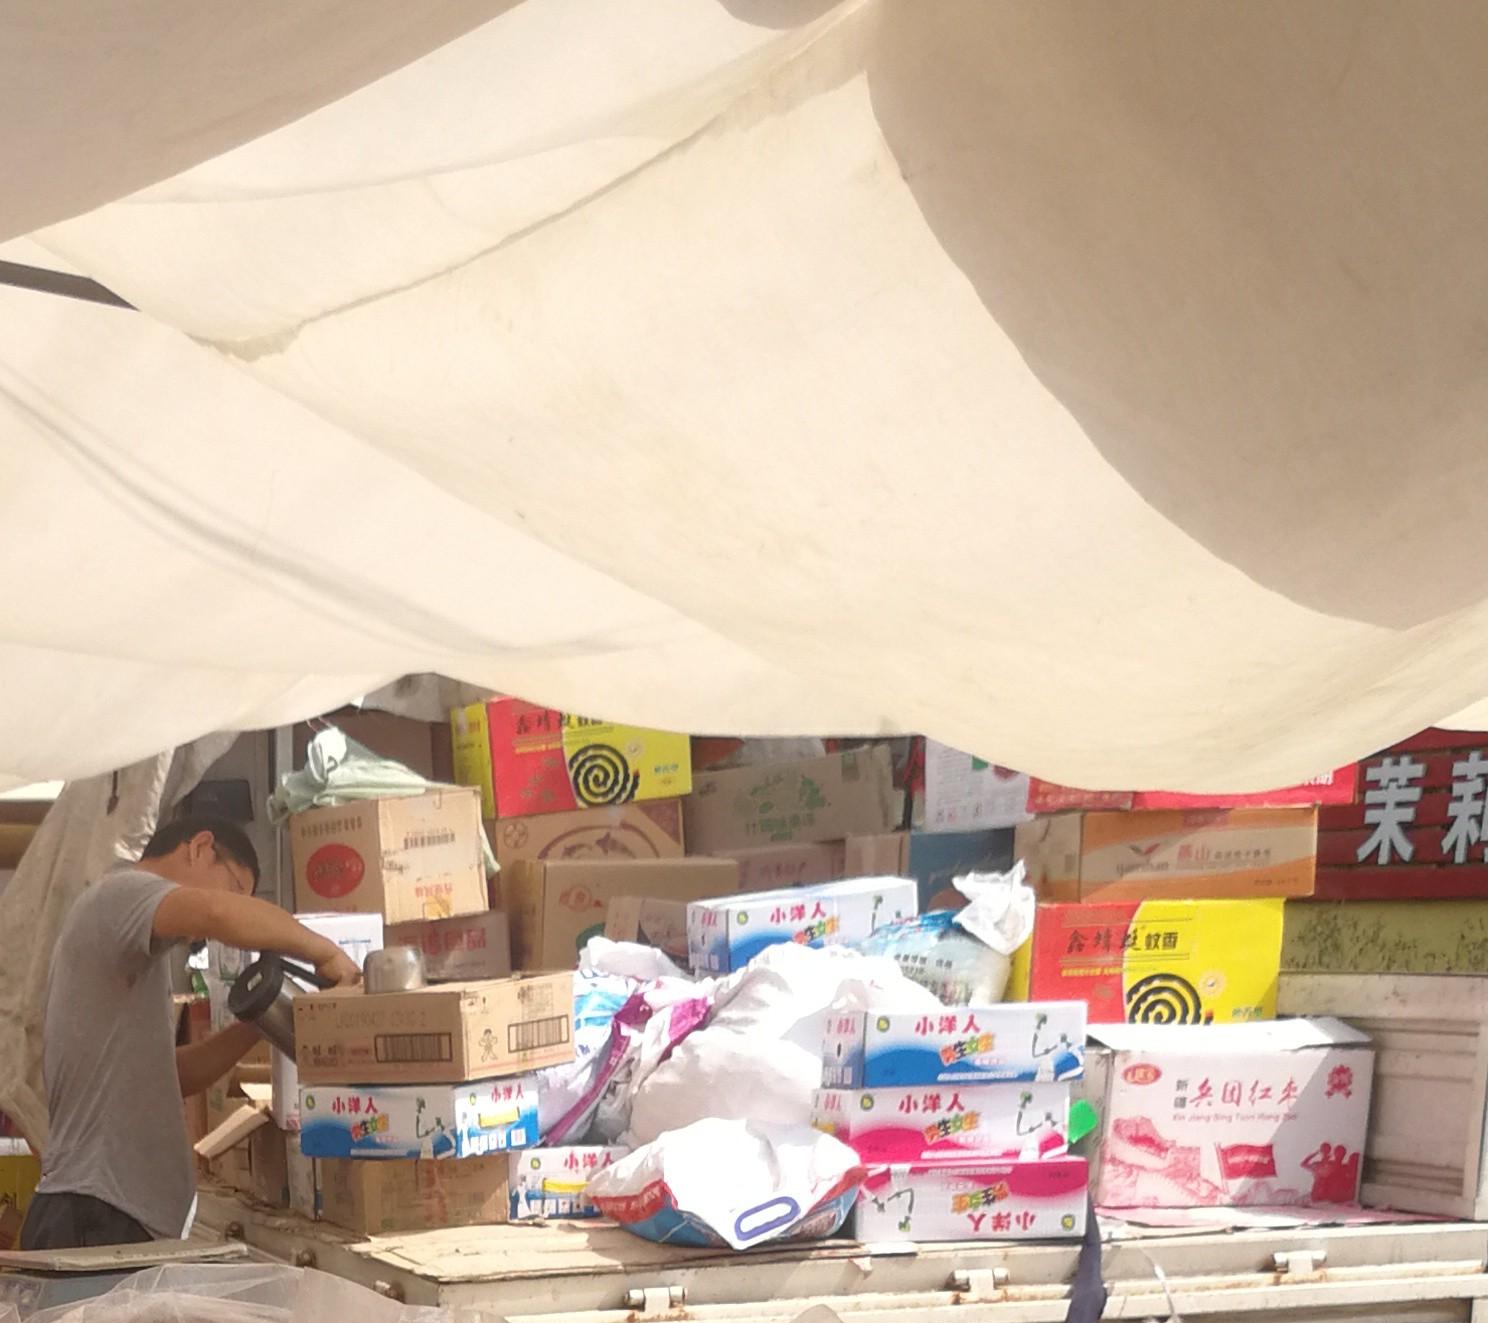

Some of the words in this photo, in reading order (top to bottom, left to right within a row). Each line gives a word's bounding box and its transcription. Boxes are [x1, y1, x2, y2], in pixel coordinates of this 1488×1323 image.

[915, 1014, 981, 1035] 小洋人
[898, 1093, 965, 1114] 小洋人
